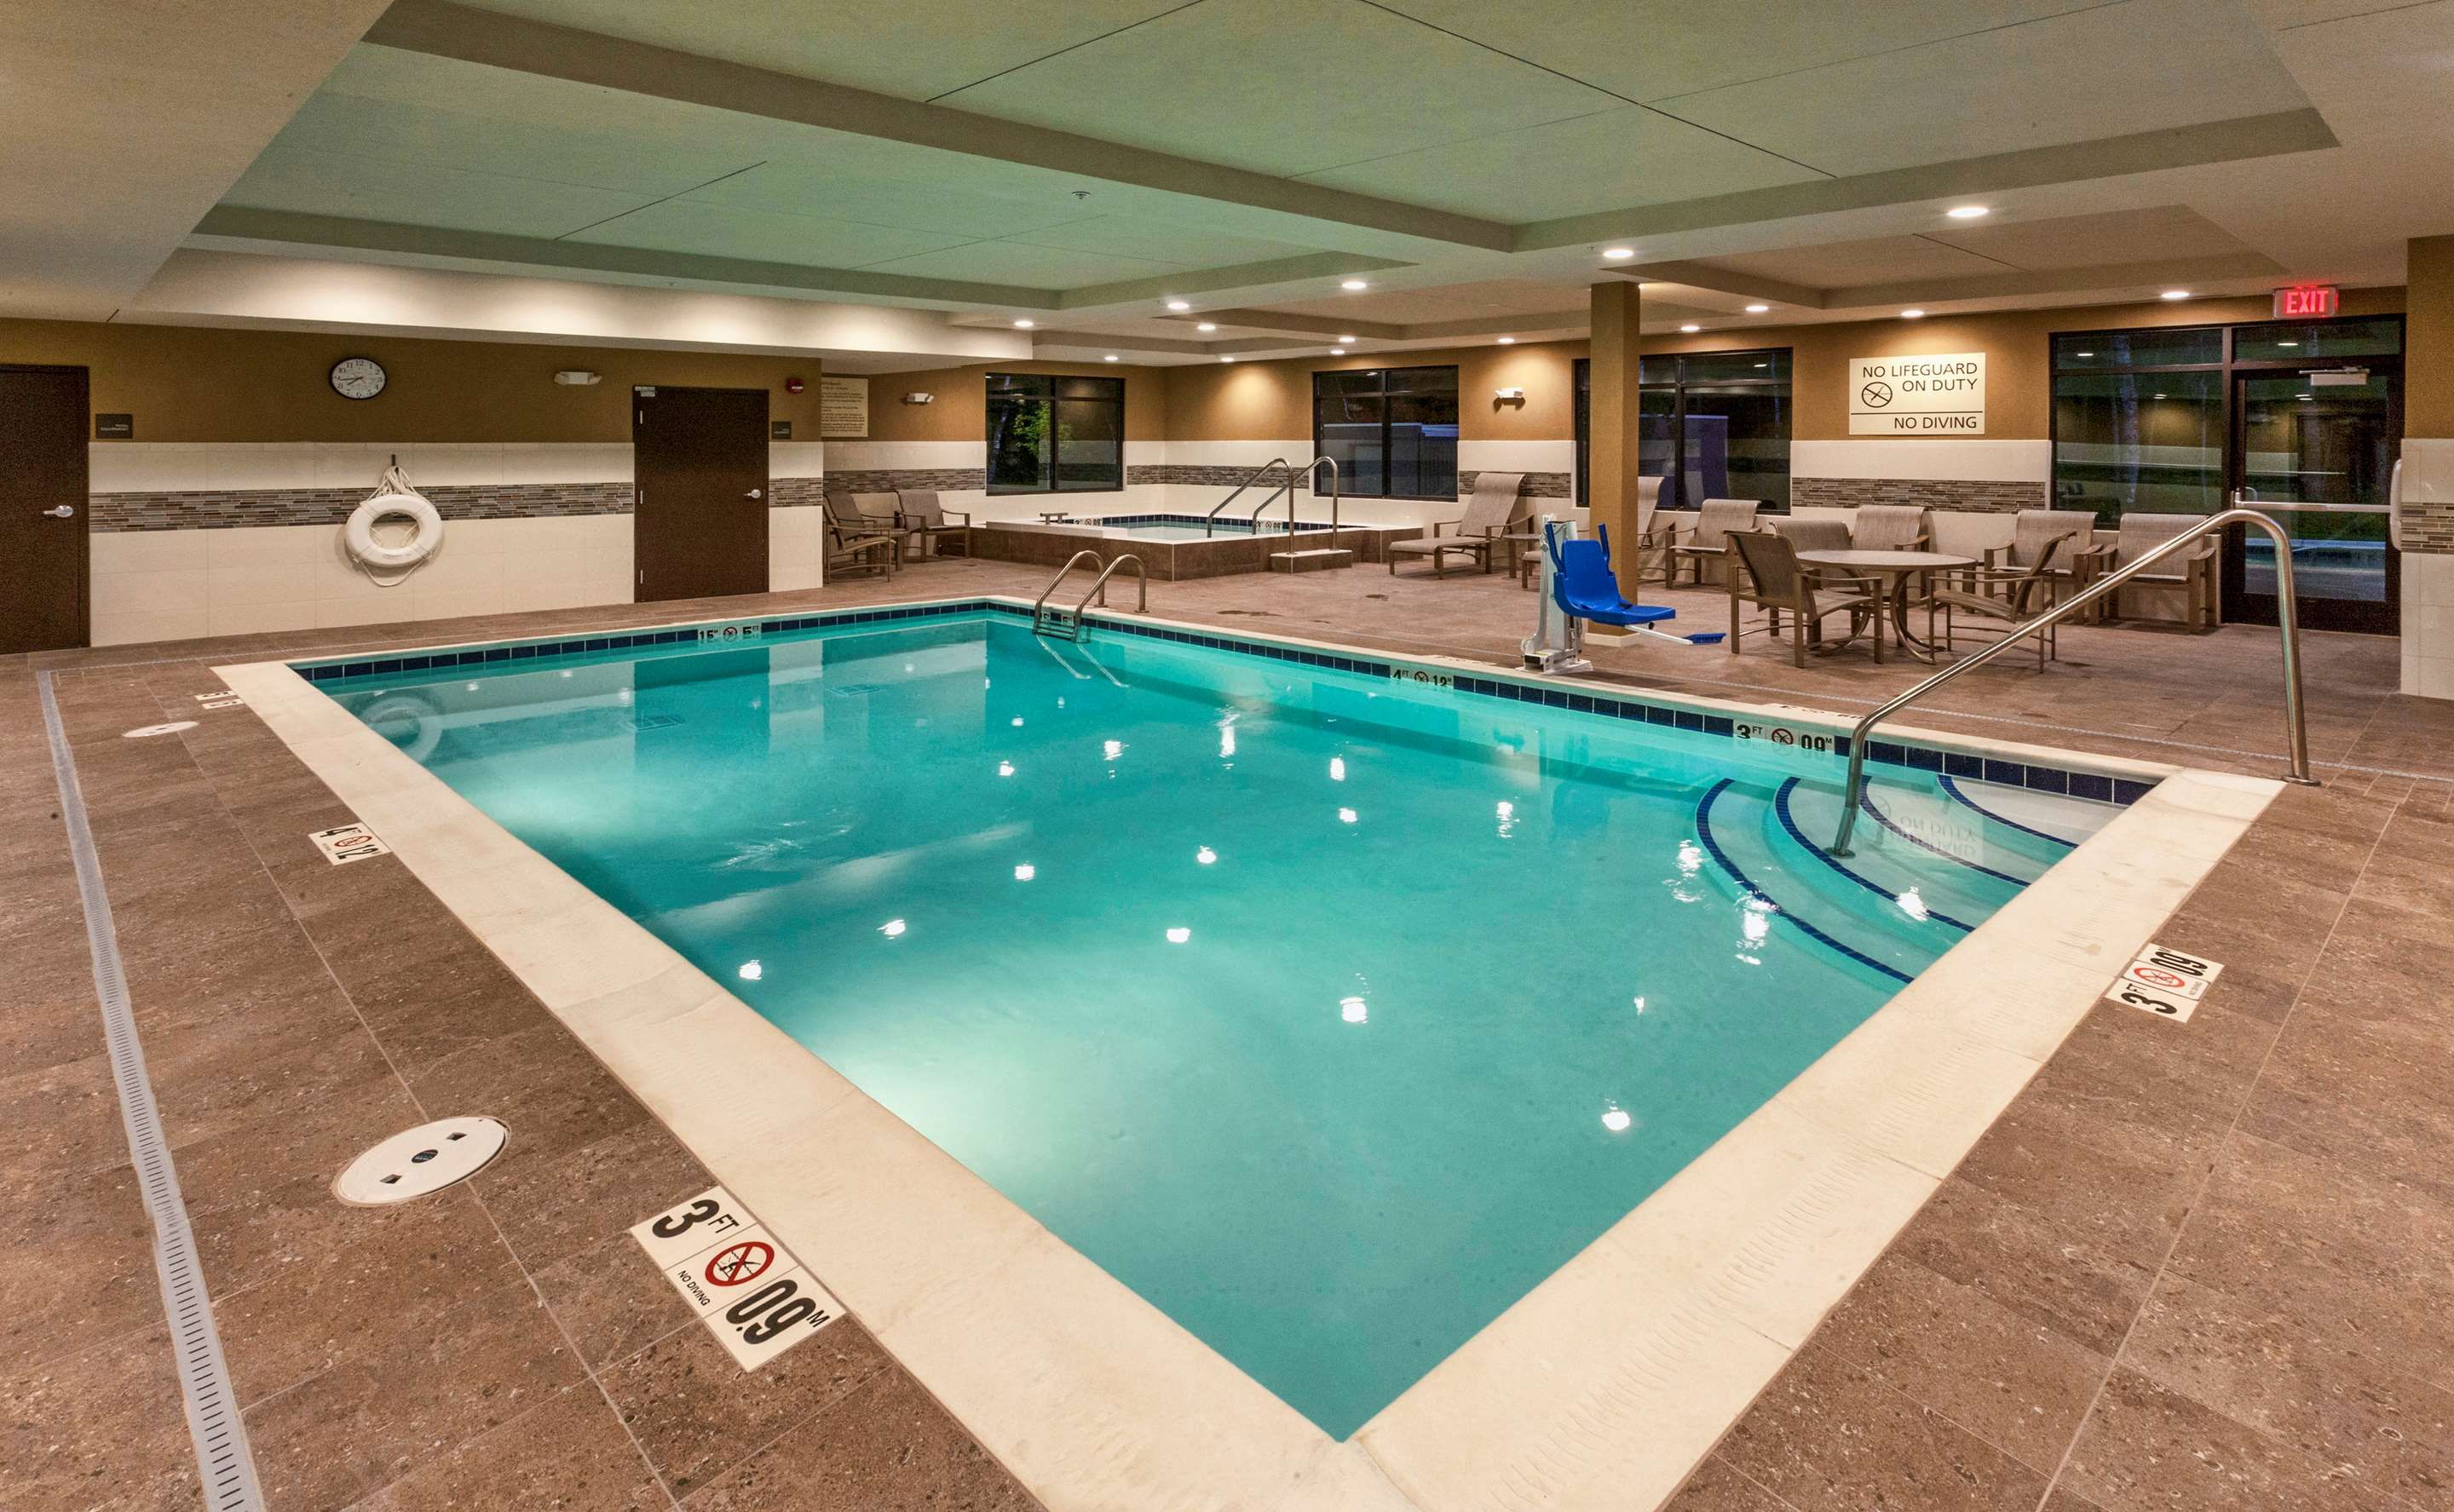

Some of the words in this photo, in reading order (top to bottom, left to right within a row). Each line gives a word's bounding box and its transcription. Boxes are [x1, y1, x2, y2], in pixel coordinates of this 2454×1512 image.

[2286, 290, 2330, 313] EXIT
[1863, 366, 1886, 377] NO
[1891, 362, 1978, 377] LIFEGUARD
[1902, 380, 1926, 392] ON
[1933, 378, 1978, 391] DUTY
[1894, 417, 1917, 428] NO
[1922, 417, 1977, 428] DIVING
[1737, 724, 1751, 739] 3
[1752, 726, 1763, 734] FT
[2126, 983, 2148, 995] FT
[2121, 992, 2178, 1015] 3
[652, 1199, 720, 1239] 3
[707, 1213, 740, 1234] FT
[677, 1270, 692, 1284] NO
[686, 1279, 711, 1307] DIVING
[725, 1279, 817, 1345] 0.9
[806, 1309, 831, 1329] M
